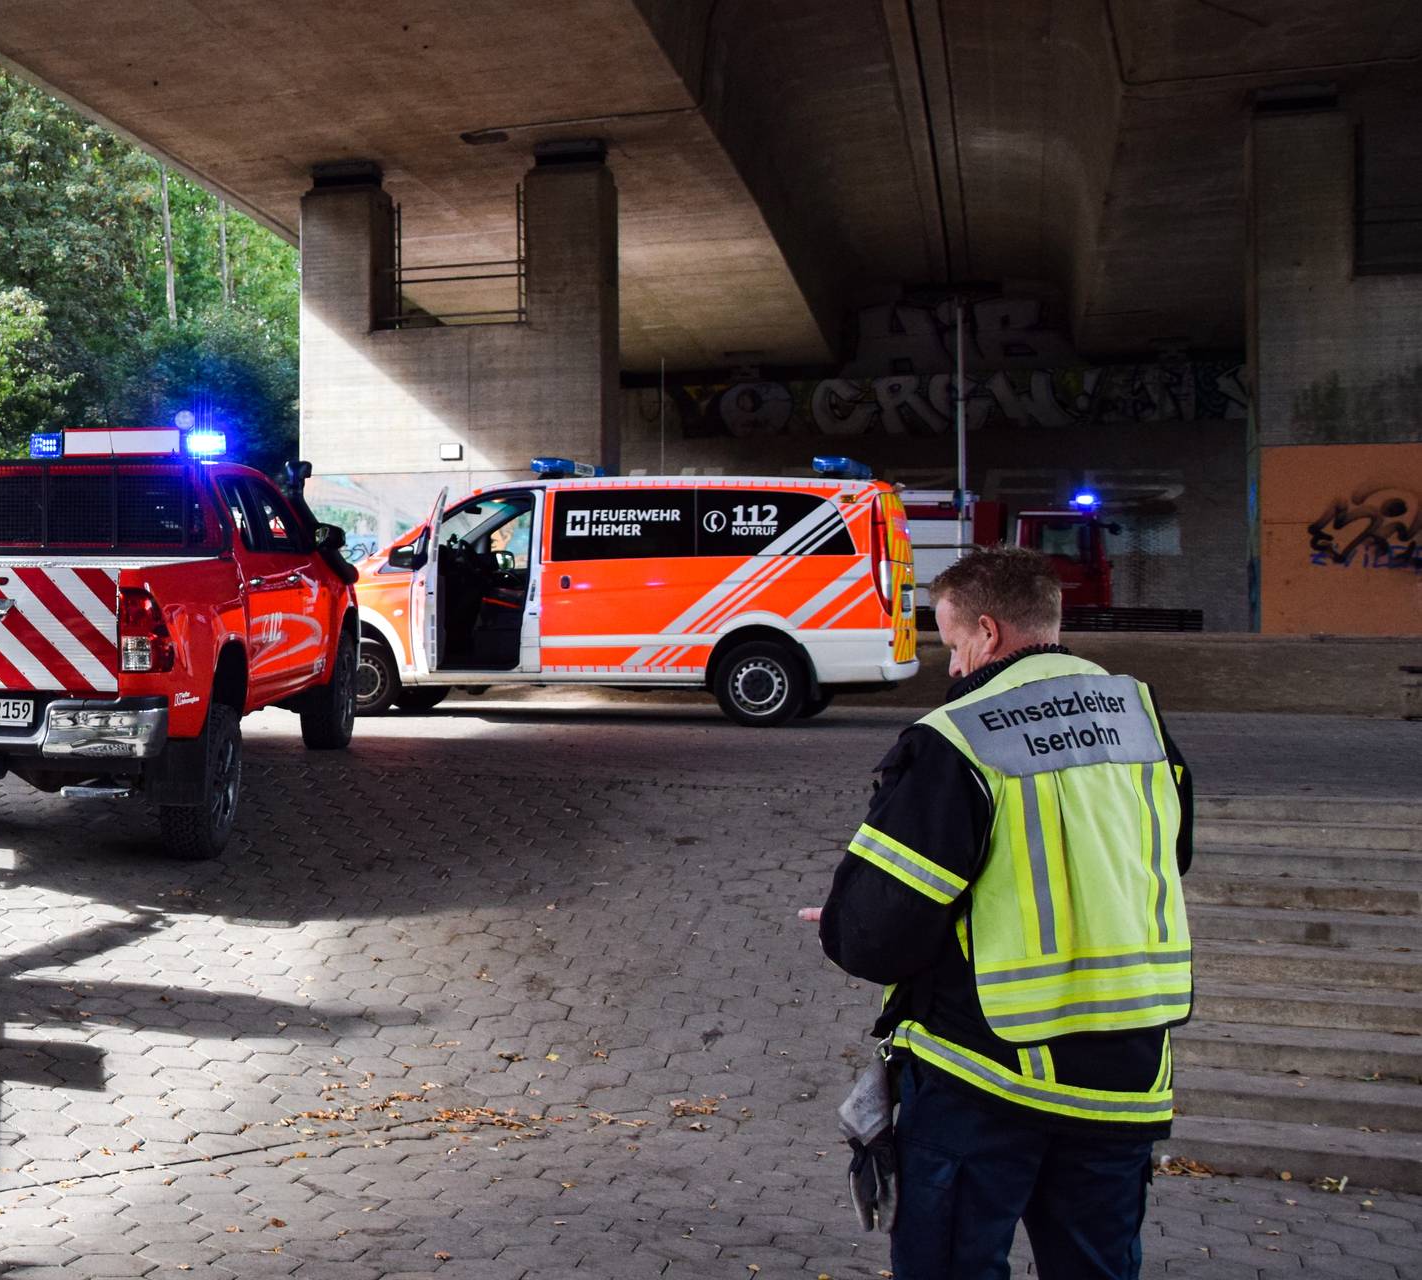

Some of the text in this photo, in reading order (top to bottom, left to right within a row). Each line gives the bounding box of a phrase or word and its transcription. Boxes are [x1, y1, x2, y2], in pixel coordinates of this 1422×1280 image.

[592, 508, 681, 522] FEUERWEHR
[731, 504, 779, 526] 112
[591, 524, 642, 536] HEMER
[731, 526, 778, 536] NOTRUF
[979, 691, 1127, 732] Einsatzleiter
[1022, 722, 1122, 757] Iserlohn
